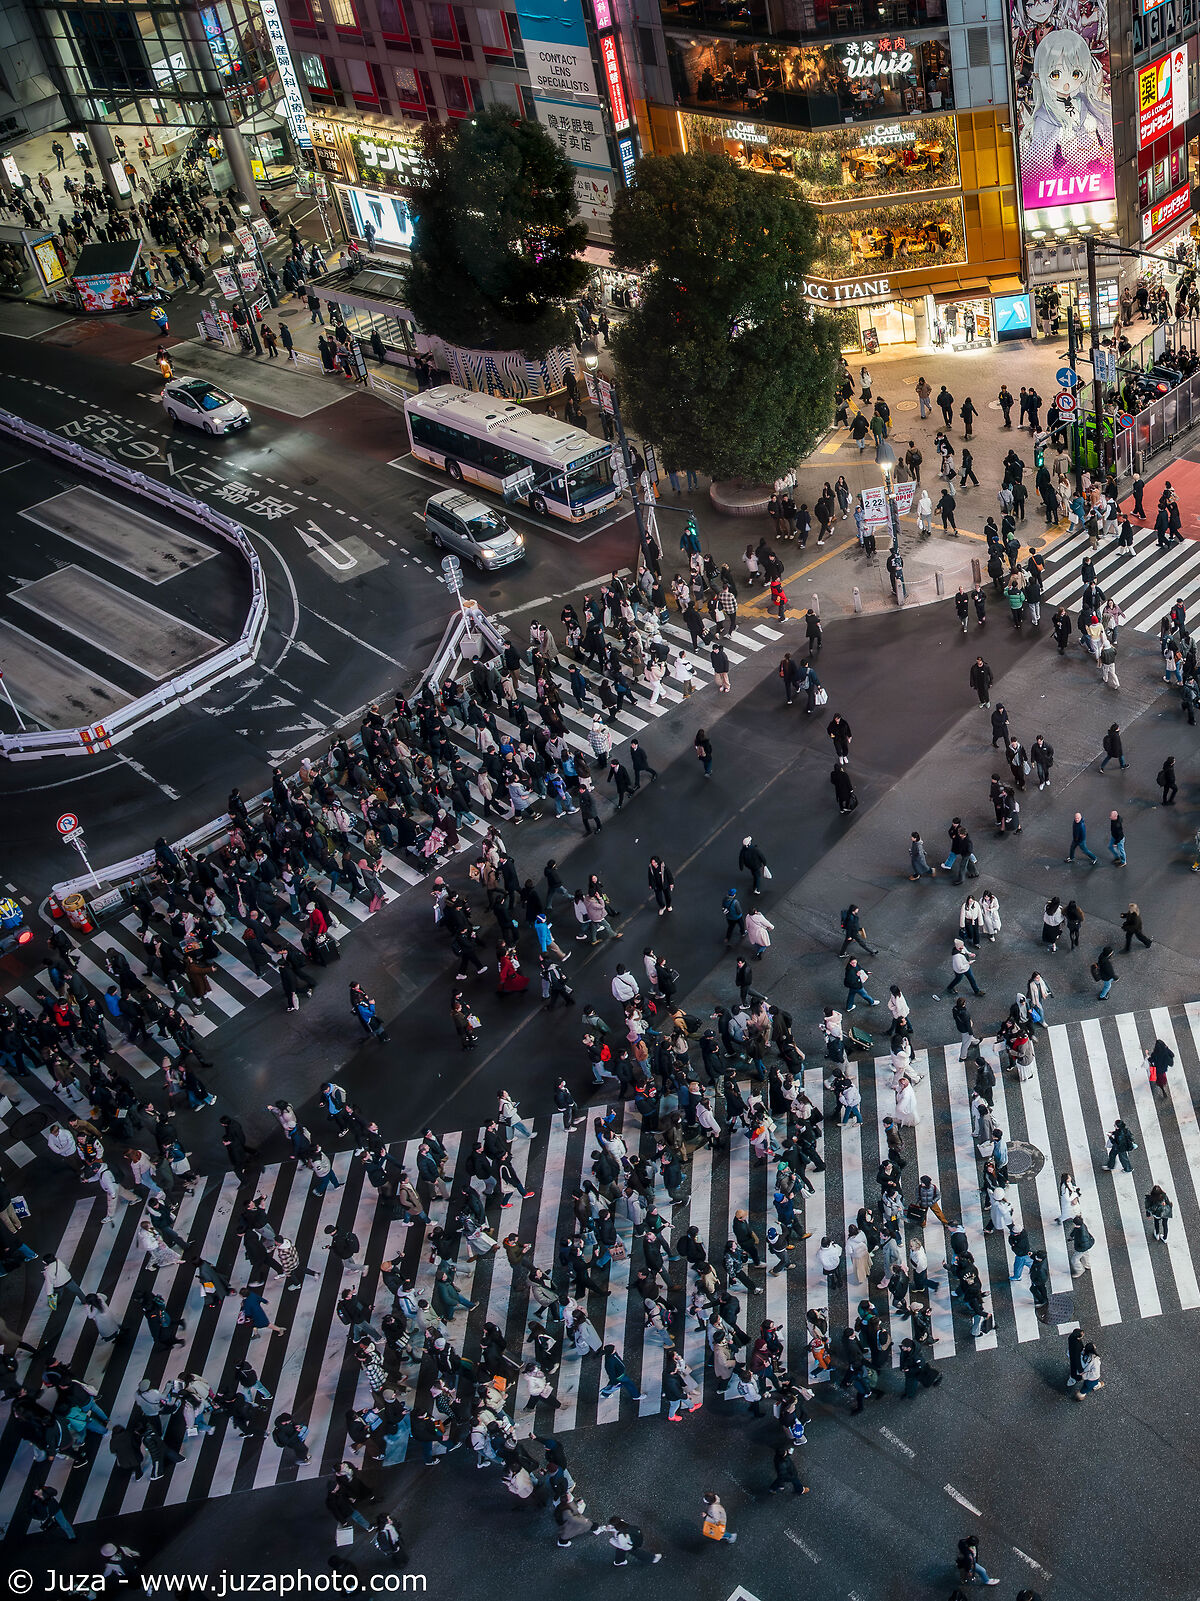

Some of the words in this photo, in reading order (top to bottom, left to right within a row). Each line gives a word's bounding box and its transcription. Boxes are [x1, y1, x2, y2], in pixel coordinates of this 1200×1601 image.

[267, 20, 283, 41] 内科
[846, 41, 876, 56] 渋谷
[878, 36, 906, 52] 焼肉
[539, 51, 577, 66] CONTACT
[842, 52, 914, 78] Ushi8
[550, 65, 571, 77] LENS
[537, 75, 590, 92] SPECIALISTS
[547, 114, 594, 136] 隐形眼镜
[1140, 107, 1173, 140] サンドラッグ
[557, 133, 592, 153] 专卖店
[860, 132, 917, 147] L'OCCITANE
[1038, 174, 1101, 198] 17LIVE
